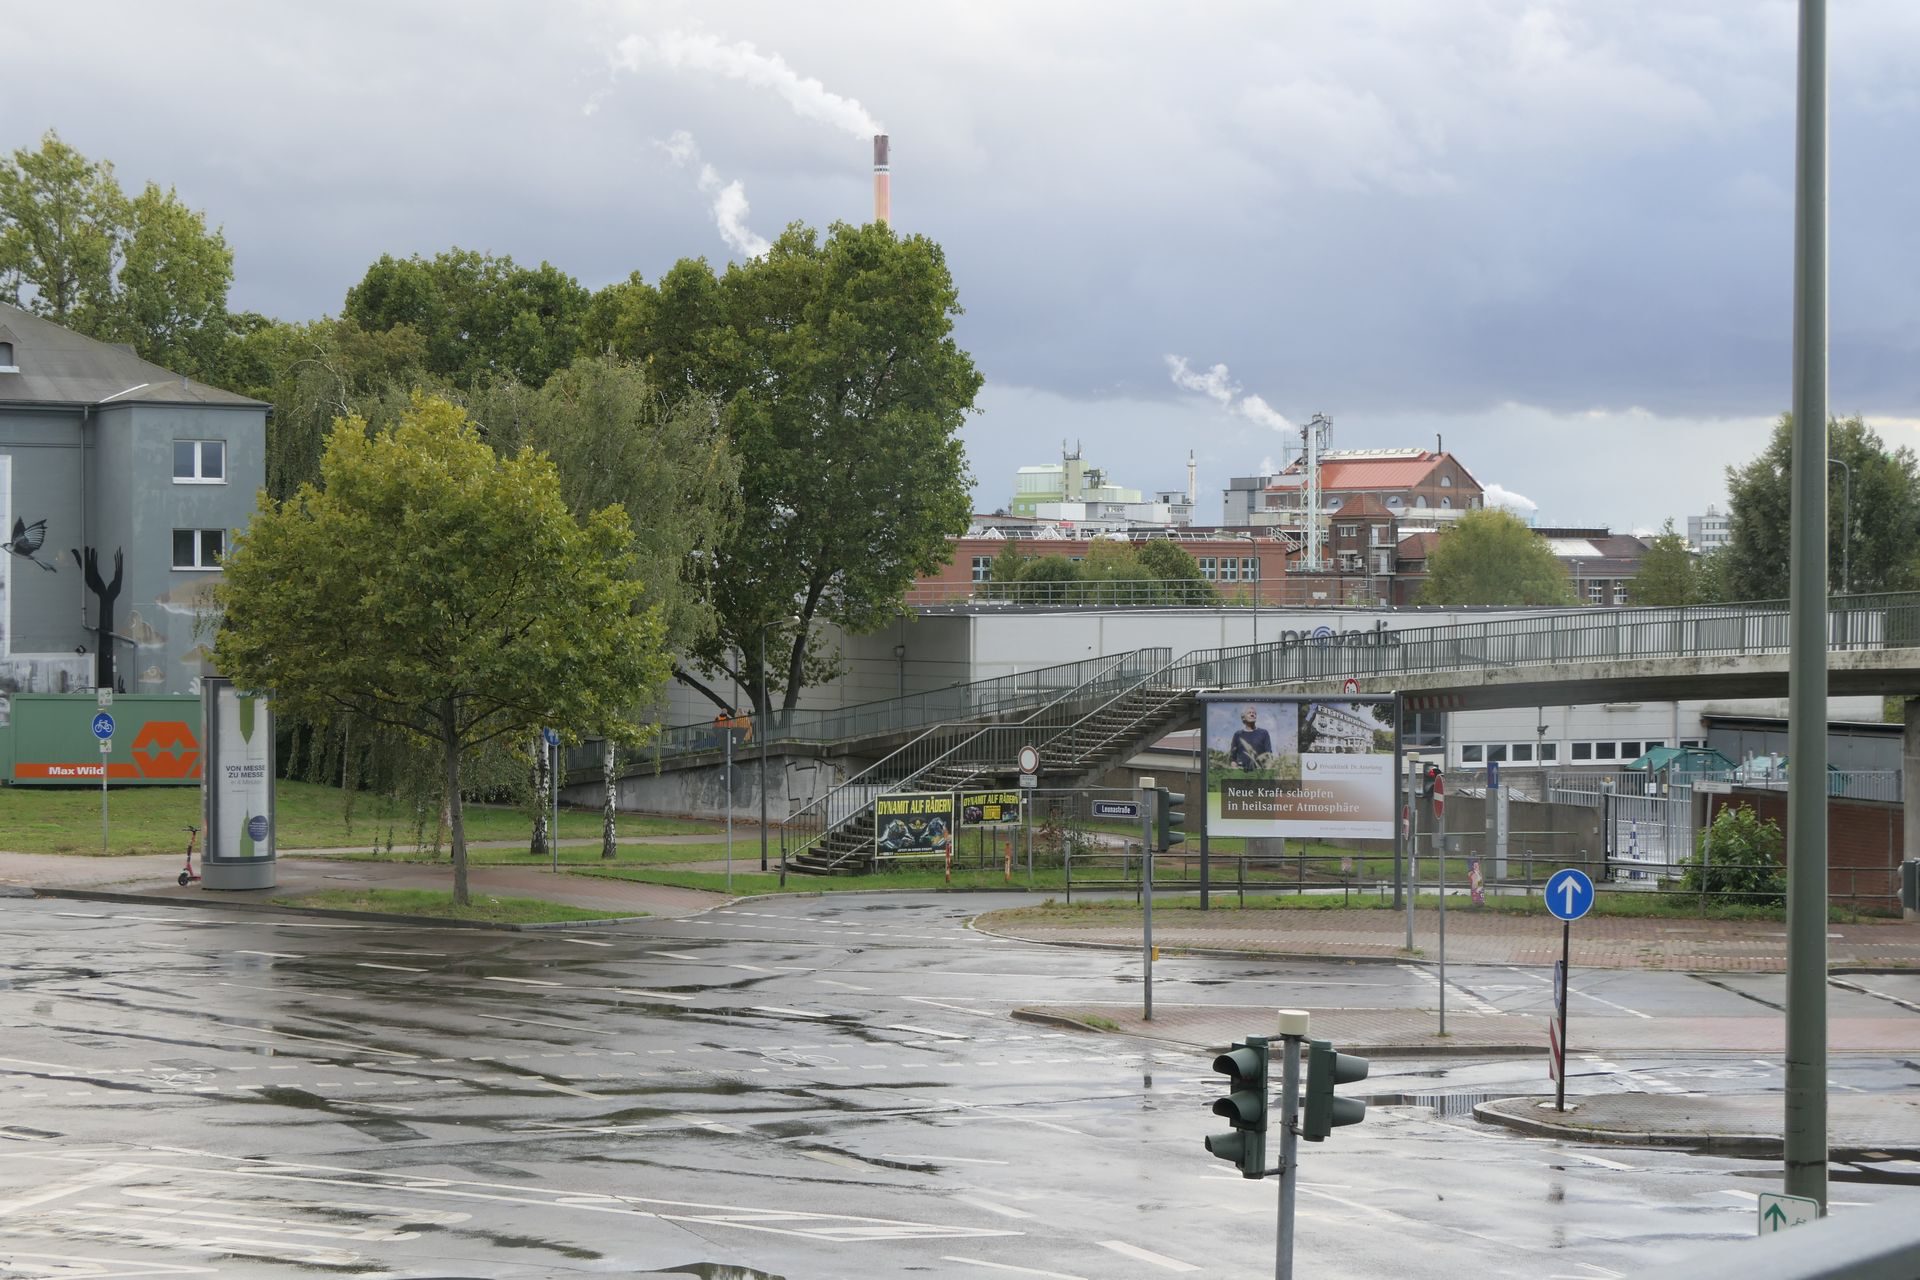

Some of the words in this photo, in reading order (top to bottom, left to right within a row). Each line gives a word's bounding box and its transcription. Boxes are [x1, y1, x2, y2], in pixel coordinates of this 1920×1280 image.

[48, 766, 75, 775] Max
[77, 766, 104, 775] Wild
[244, 764, 265, 772] MESSE
[963, 795, 987, 807] DYNAMIT
[987, 793, 999, 804] AUF
[999, 792, 1019, 804] RÄDERN
[1228, 788, 1254, 797] Neue
[1258, 788, 1283, 798] Kraft
[1286, 788, 1334, 799] schöpfen
[878, 801, 909, 815] DYNAMIT
[910, 800, 924, 814] AUF
[925, 796, 952, 814] RÄDERN
[1228, 801, 1238, 811] in
[1242, 801, 1293, 812] heilsamer
[1297, 802, 1360, 814] Atmosphäre
